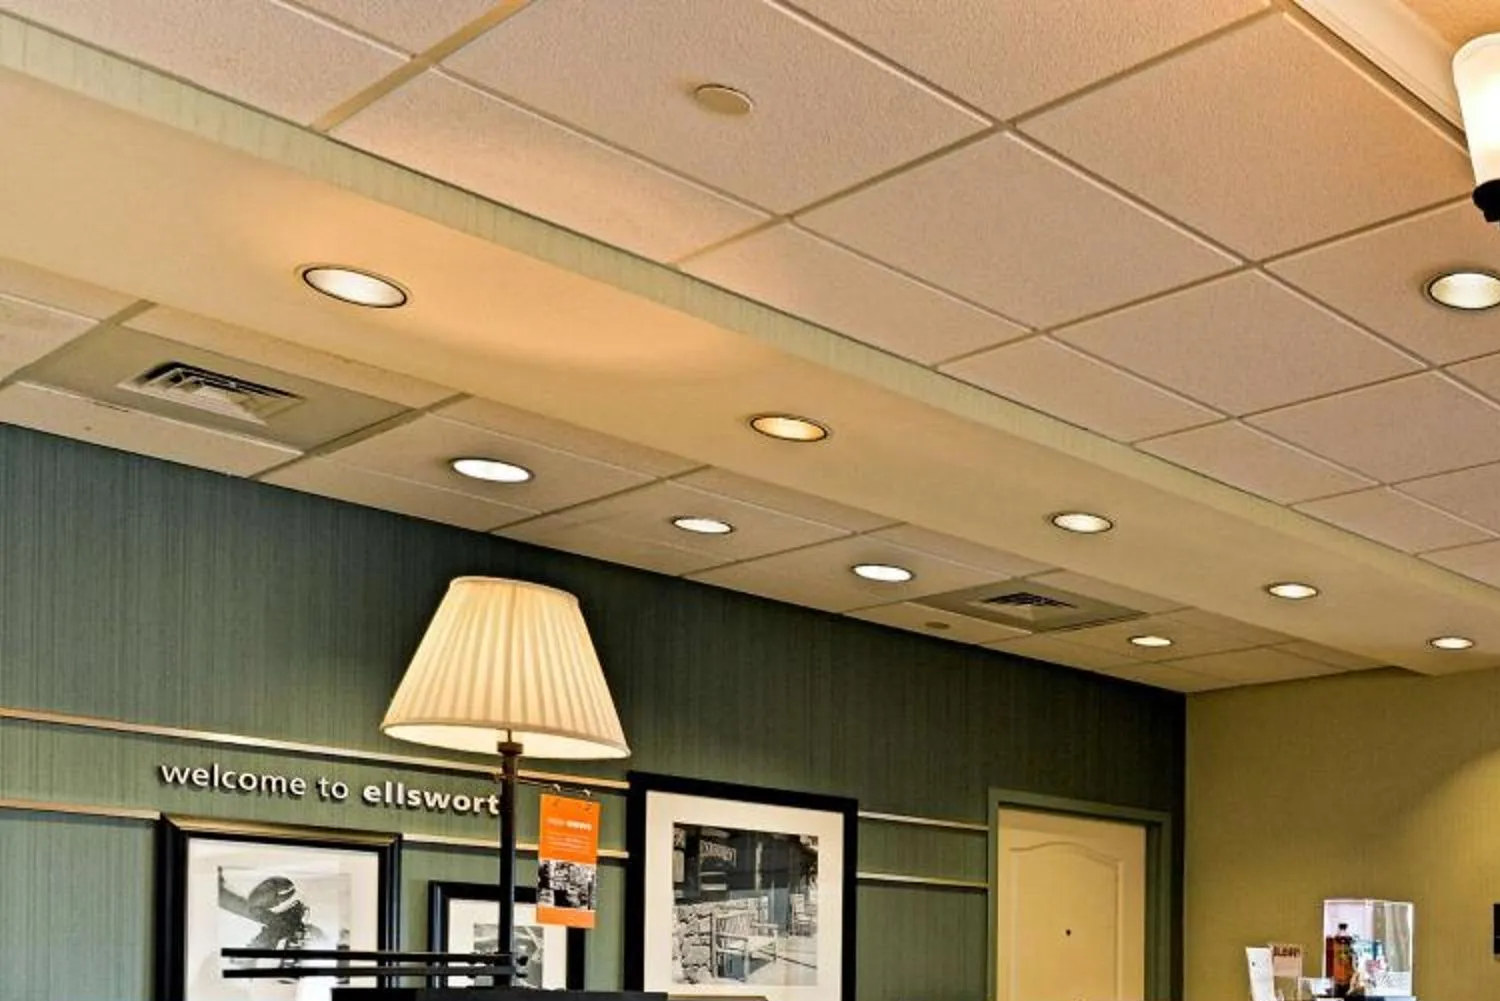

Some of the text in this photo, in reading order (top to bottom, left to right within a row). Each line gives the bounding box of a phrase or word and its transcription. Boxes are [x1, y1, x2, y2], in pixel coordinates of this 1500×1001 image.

[159, 763, 500, 816] welcome to ellswort
